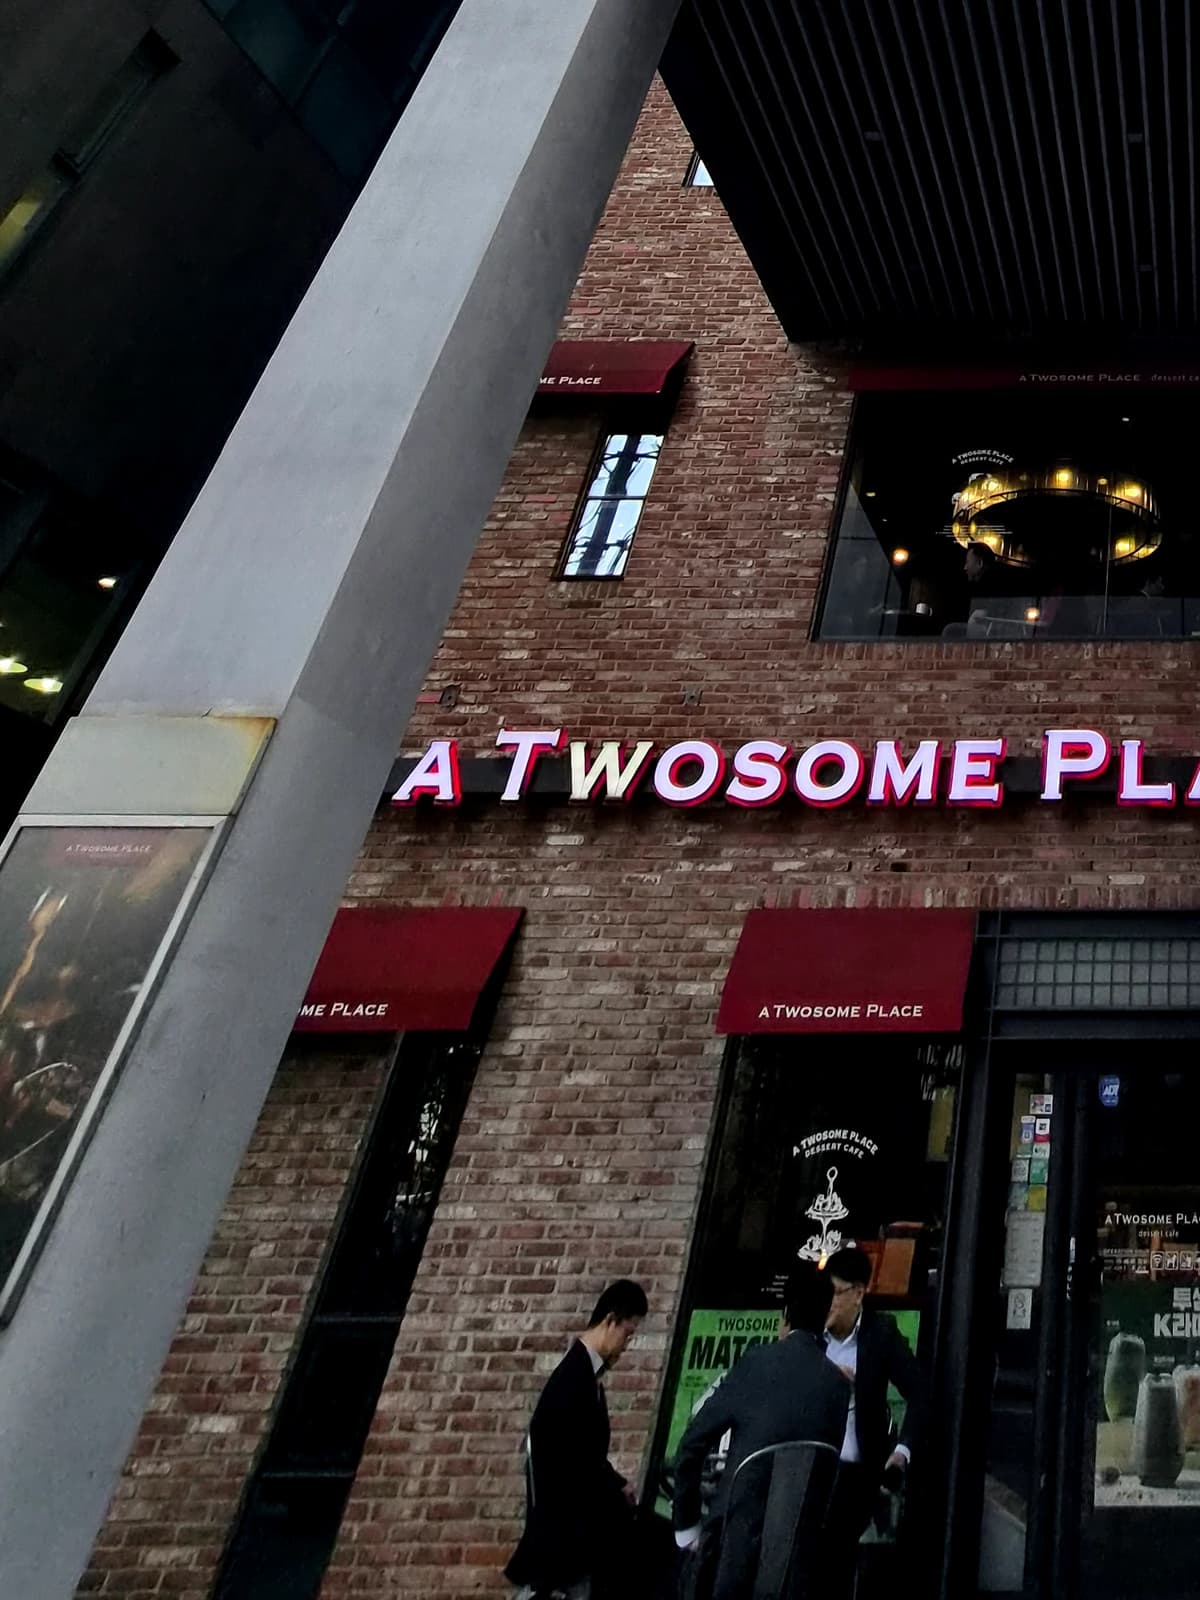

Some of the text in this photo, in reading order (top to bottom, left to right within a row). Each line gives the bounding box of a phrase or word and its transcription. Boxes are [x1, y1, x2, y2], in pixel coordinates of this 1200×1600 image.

[558, 376, 602, 385] PLACE
[1029, 373, 1094, 383] TWOSOME
[1098, 372, 1141, 383] PLACE
[392, 740, 462, 806] A
[494, 728, 1005, 808] TWOSOME
[330, 1002, 389, 1016] PLACE
[758, 1004, 923, 1019] A TWOSOME PLACE
[800, 1129, 848, 1148] TWOSOME
[849, 1130, 879, 1156] PLACE
[805, 1143, 865, 1159] DESSERT CAFE
[1114, 1213, 1172, 1225] TWOSOME
[718, 1318, 780, 1332] TWOSOME
